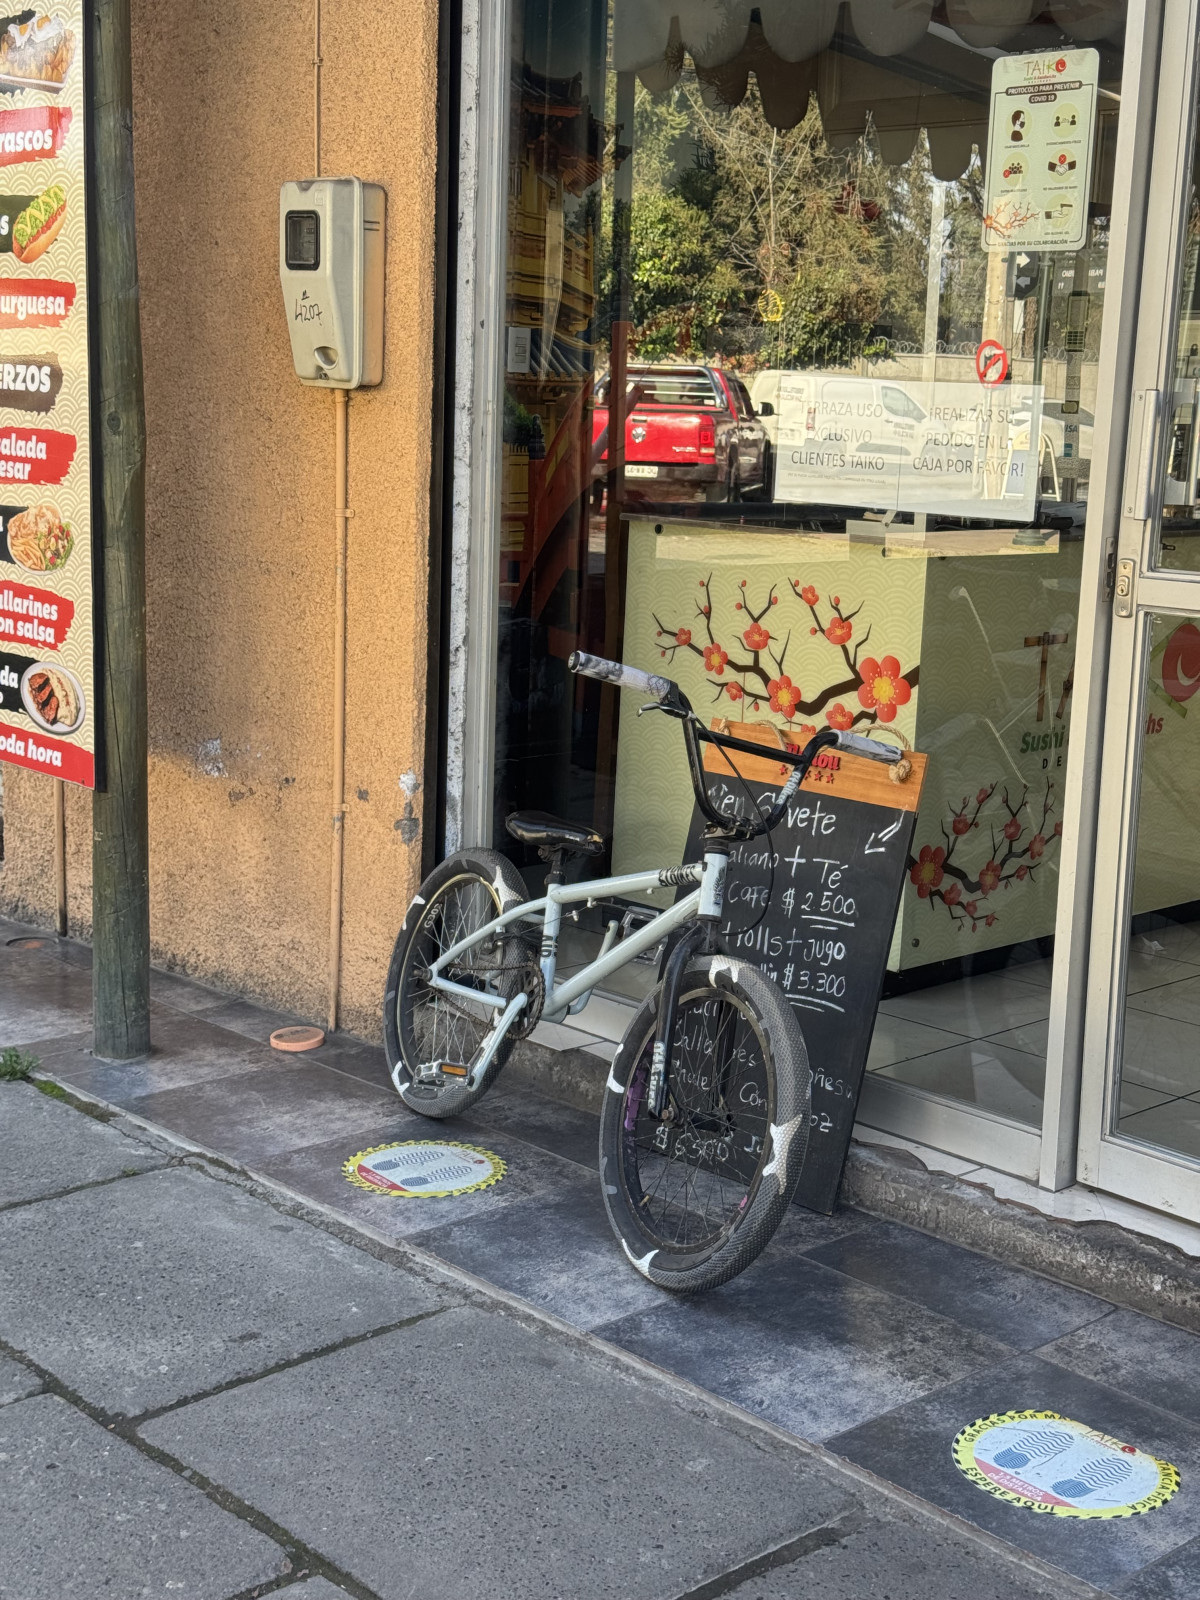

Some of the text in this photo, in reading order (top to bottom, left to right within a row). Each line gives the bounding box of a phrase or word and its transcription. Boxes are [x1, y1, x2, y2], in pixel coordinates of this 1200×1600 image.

[1008, 86, 1038, 95] PROTOCOLO
[1053, 82, 1080, 91] PREVENIR
[294, 298, 323, 323] 4207
[857, 403, 883, 418] USO
[807, 426, 873, 444] XCLUSIVO
[926, 431, 974, 448] PEDIDO
[979, 435, 994, 449] EN
[0, 433, 47, 460] alada
[791, 450, 885, 471] CLIENTES TAIKO
[912, 457, 1024, 477] CAJA POR FAVOR!
[16, 618, 55, 644] salsa
[27, 738, 62, 767] hora
[963, 1417, 1007, 1443] GRACIAS
[1007, 1412, 1039, 1422] POR
[965, 1466, 1011, 1498] ESPERE
[1000, 1478, 1043, 1501] DISTANCIA
[1012, 1478, 1046, 1497] METROS
